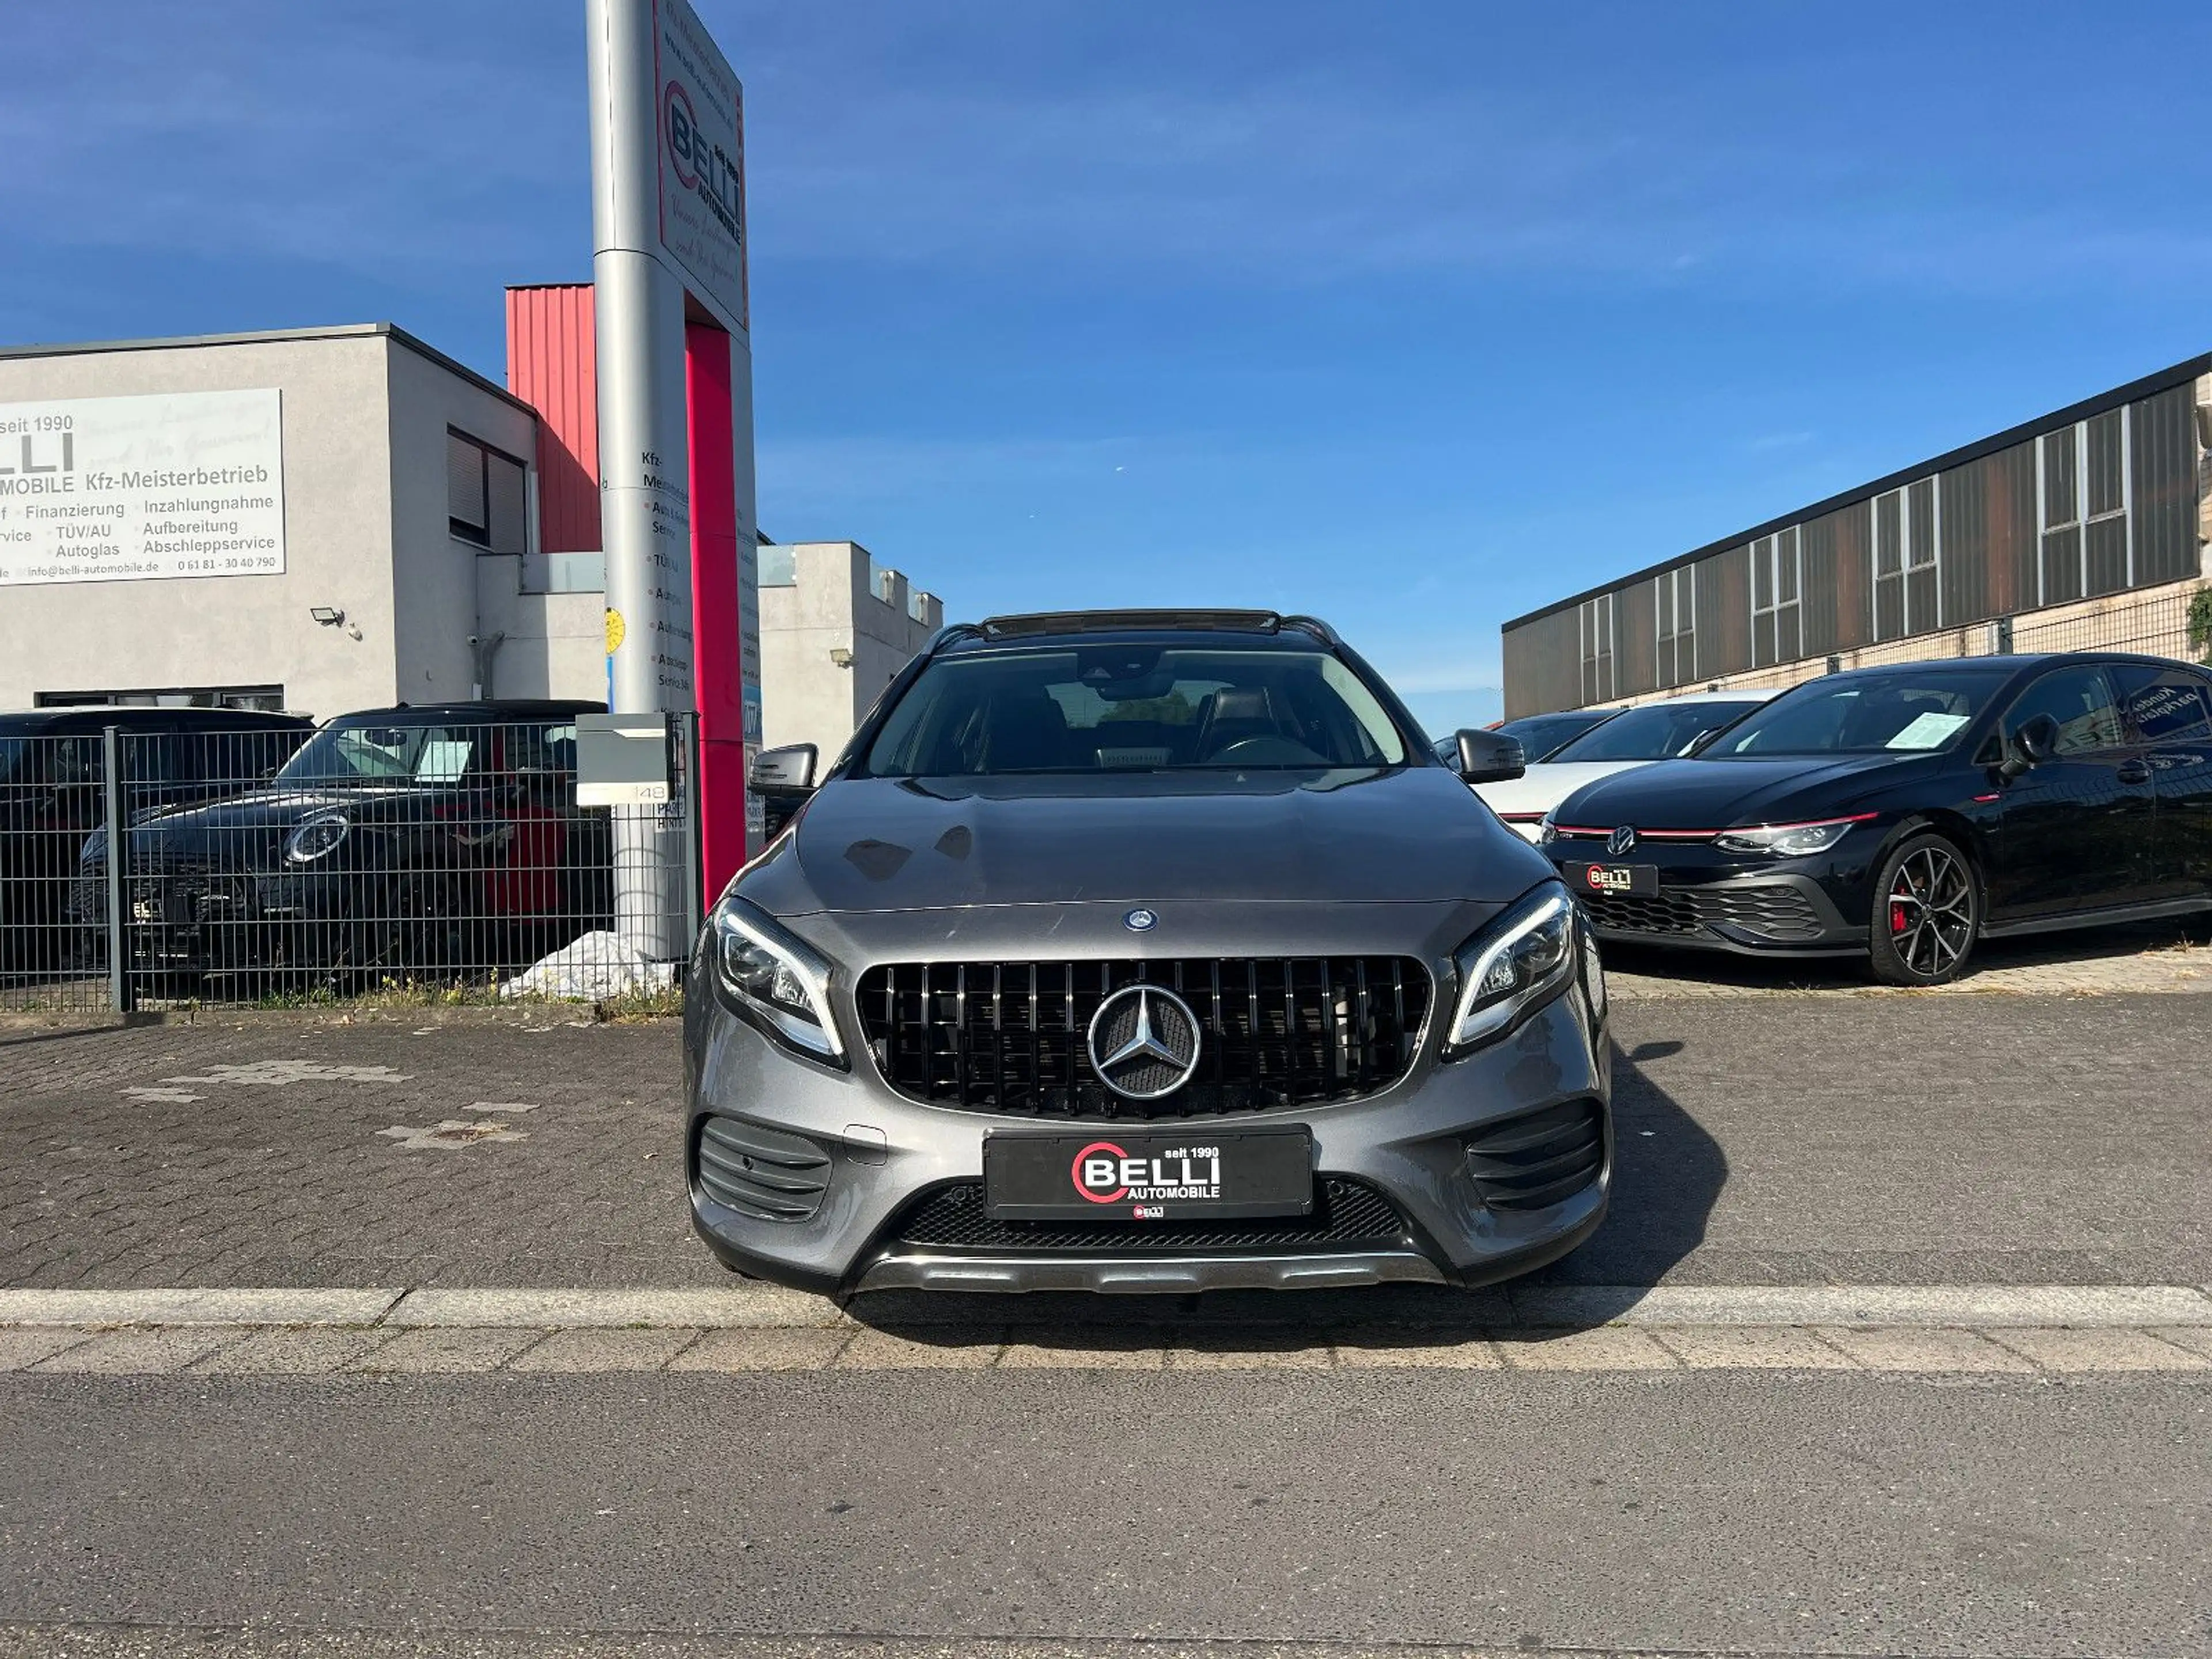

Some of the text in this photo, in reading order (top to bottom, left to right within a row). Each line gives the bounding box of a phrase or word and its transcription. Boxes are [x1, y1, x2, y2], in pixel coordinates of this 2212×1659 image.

[672, 103, 740, 225] BELLI
[0, 415, 73, 433] seit 1990
[0, 433, 73, 474] LI
[86, 465, 267, 490] Kfz-Meisterbetrieb
[26, 503, 124, 518] Finanzierung
[145, 495, 273, 513] Inzahlungnahme
[56, 523, 111, 539] TÜV/AU
[143, 520, 237, 534] Aufbereitung
[56, 536, 275, 559] Autoglas Abschleppservice
[28, 562, 158, 577] info@belli-automobile.de
[1591, 870, 1631, 884] BELLI
[1165, 1147, 1219, 1158] seit 1990
[1085, 1158, 1220, 1187] BELLI
[1127, 1187, 1220, 1199] AUTOMOBILE
